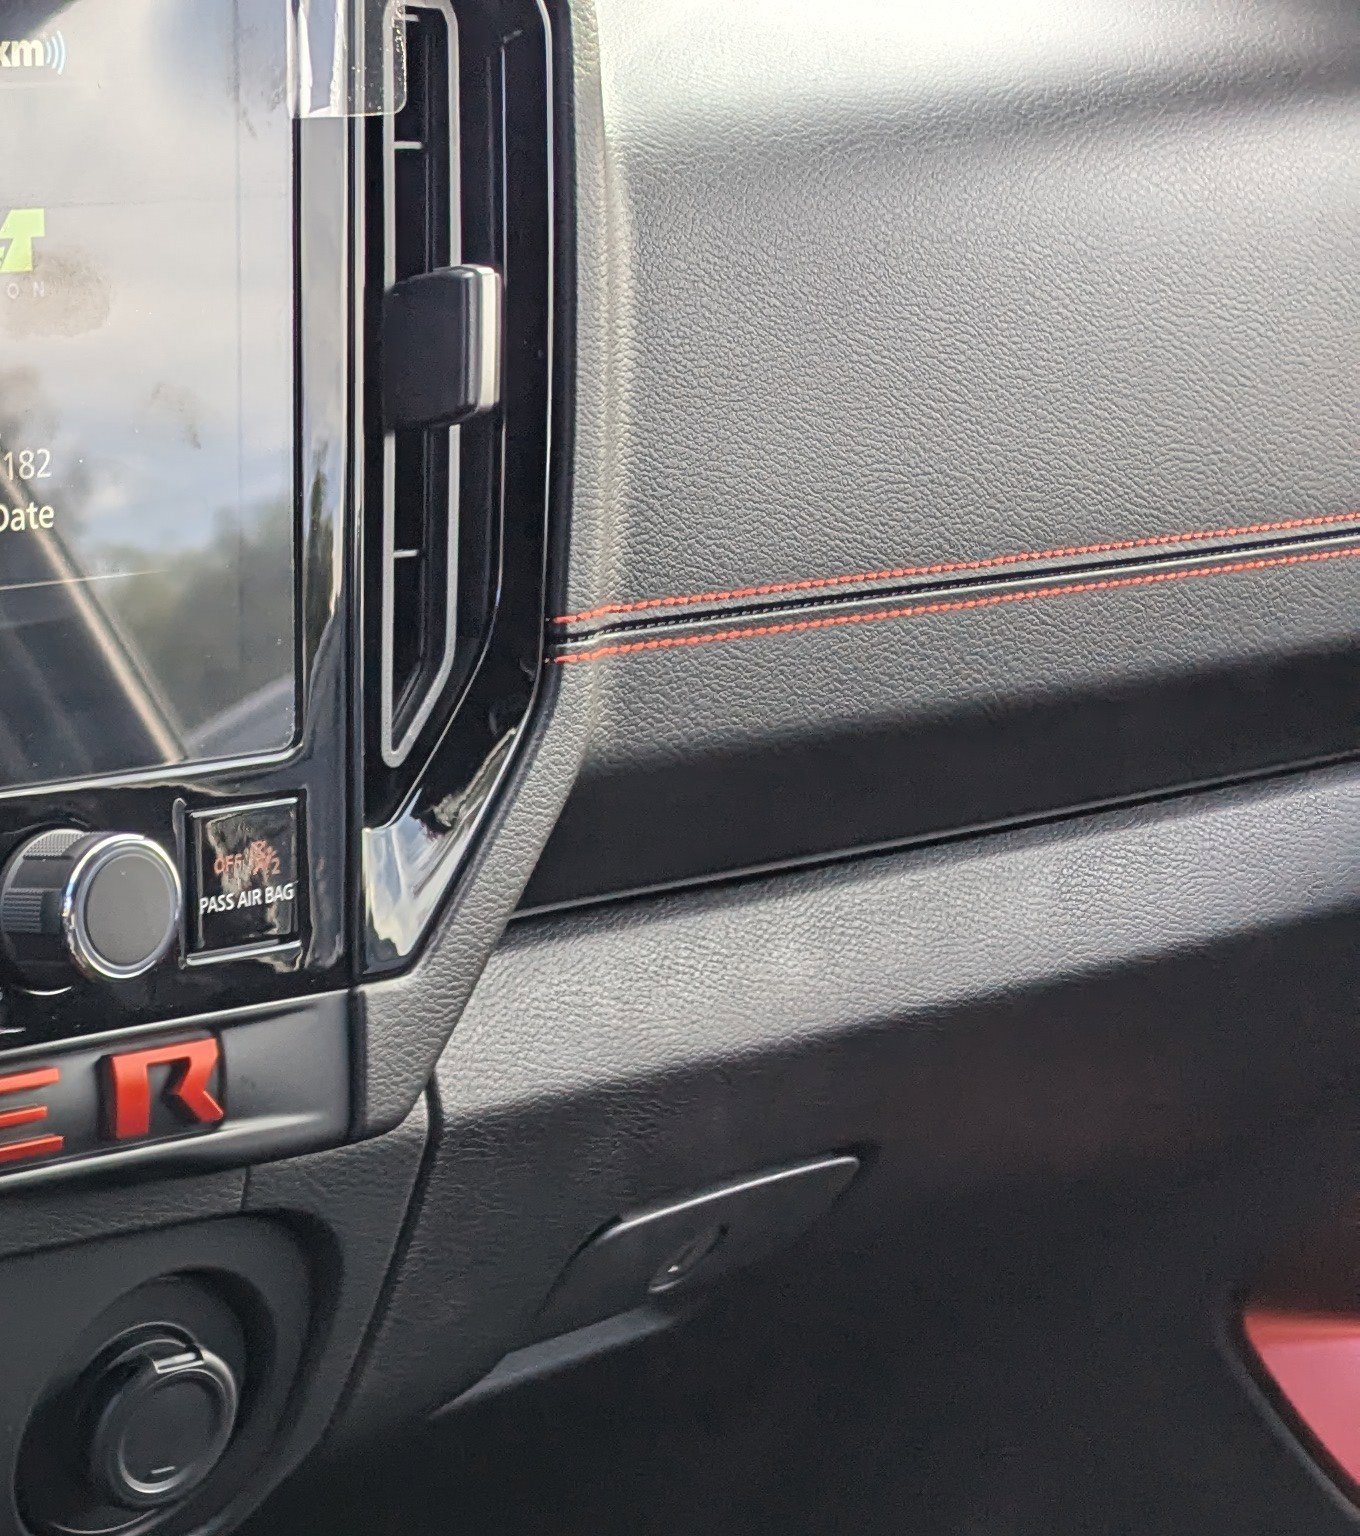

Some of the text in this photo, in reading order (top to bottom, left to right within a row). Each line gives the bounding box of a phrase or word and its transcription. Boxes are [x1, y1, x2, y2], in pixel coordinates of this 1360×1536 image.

[200, 883, 295, 914] PASS AIR BAG
